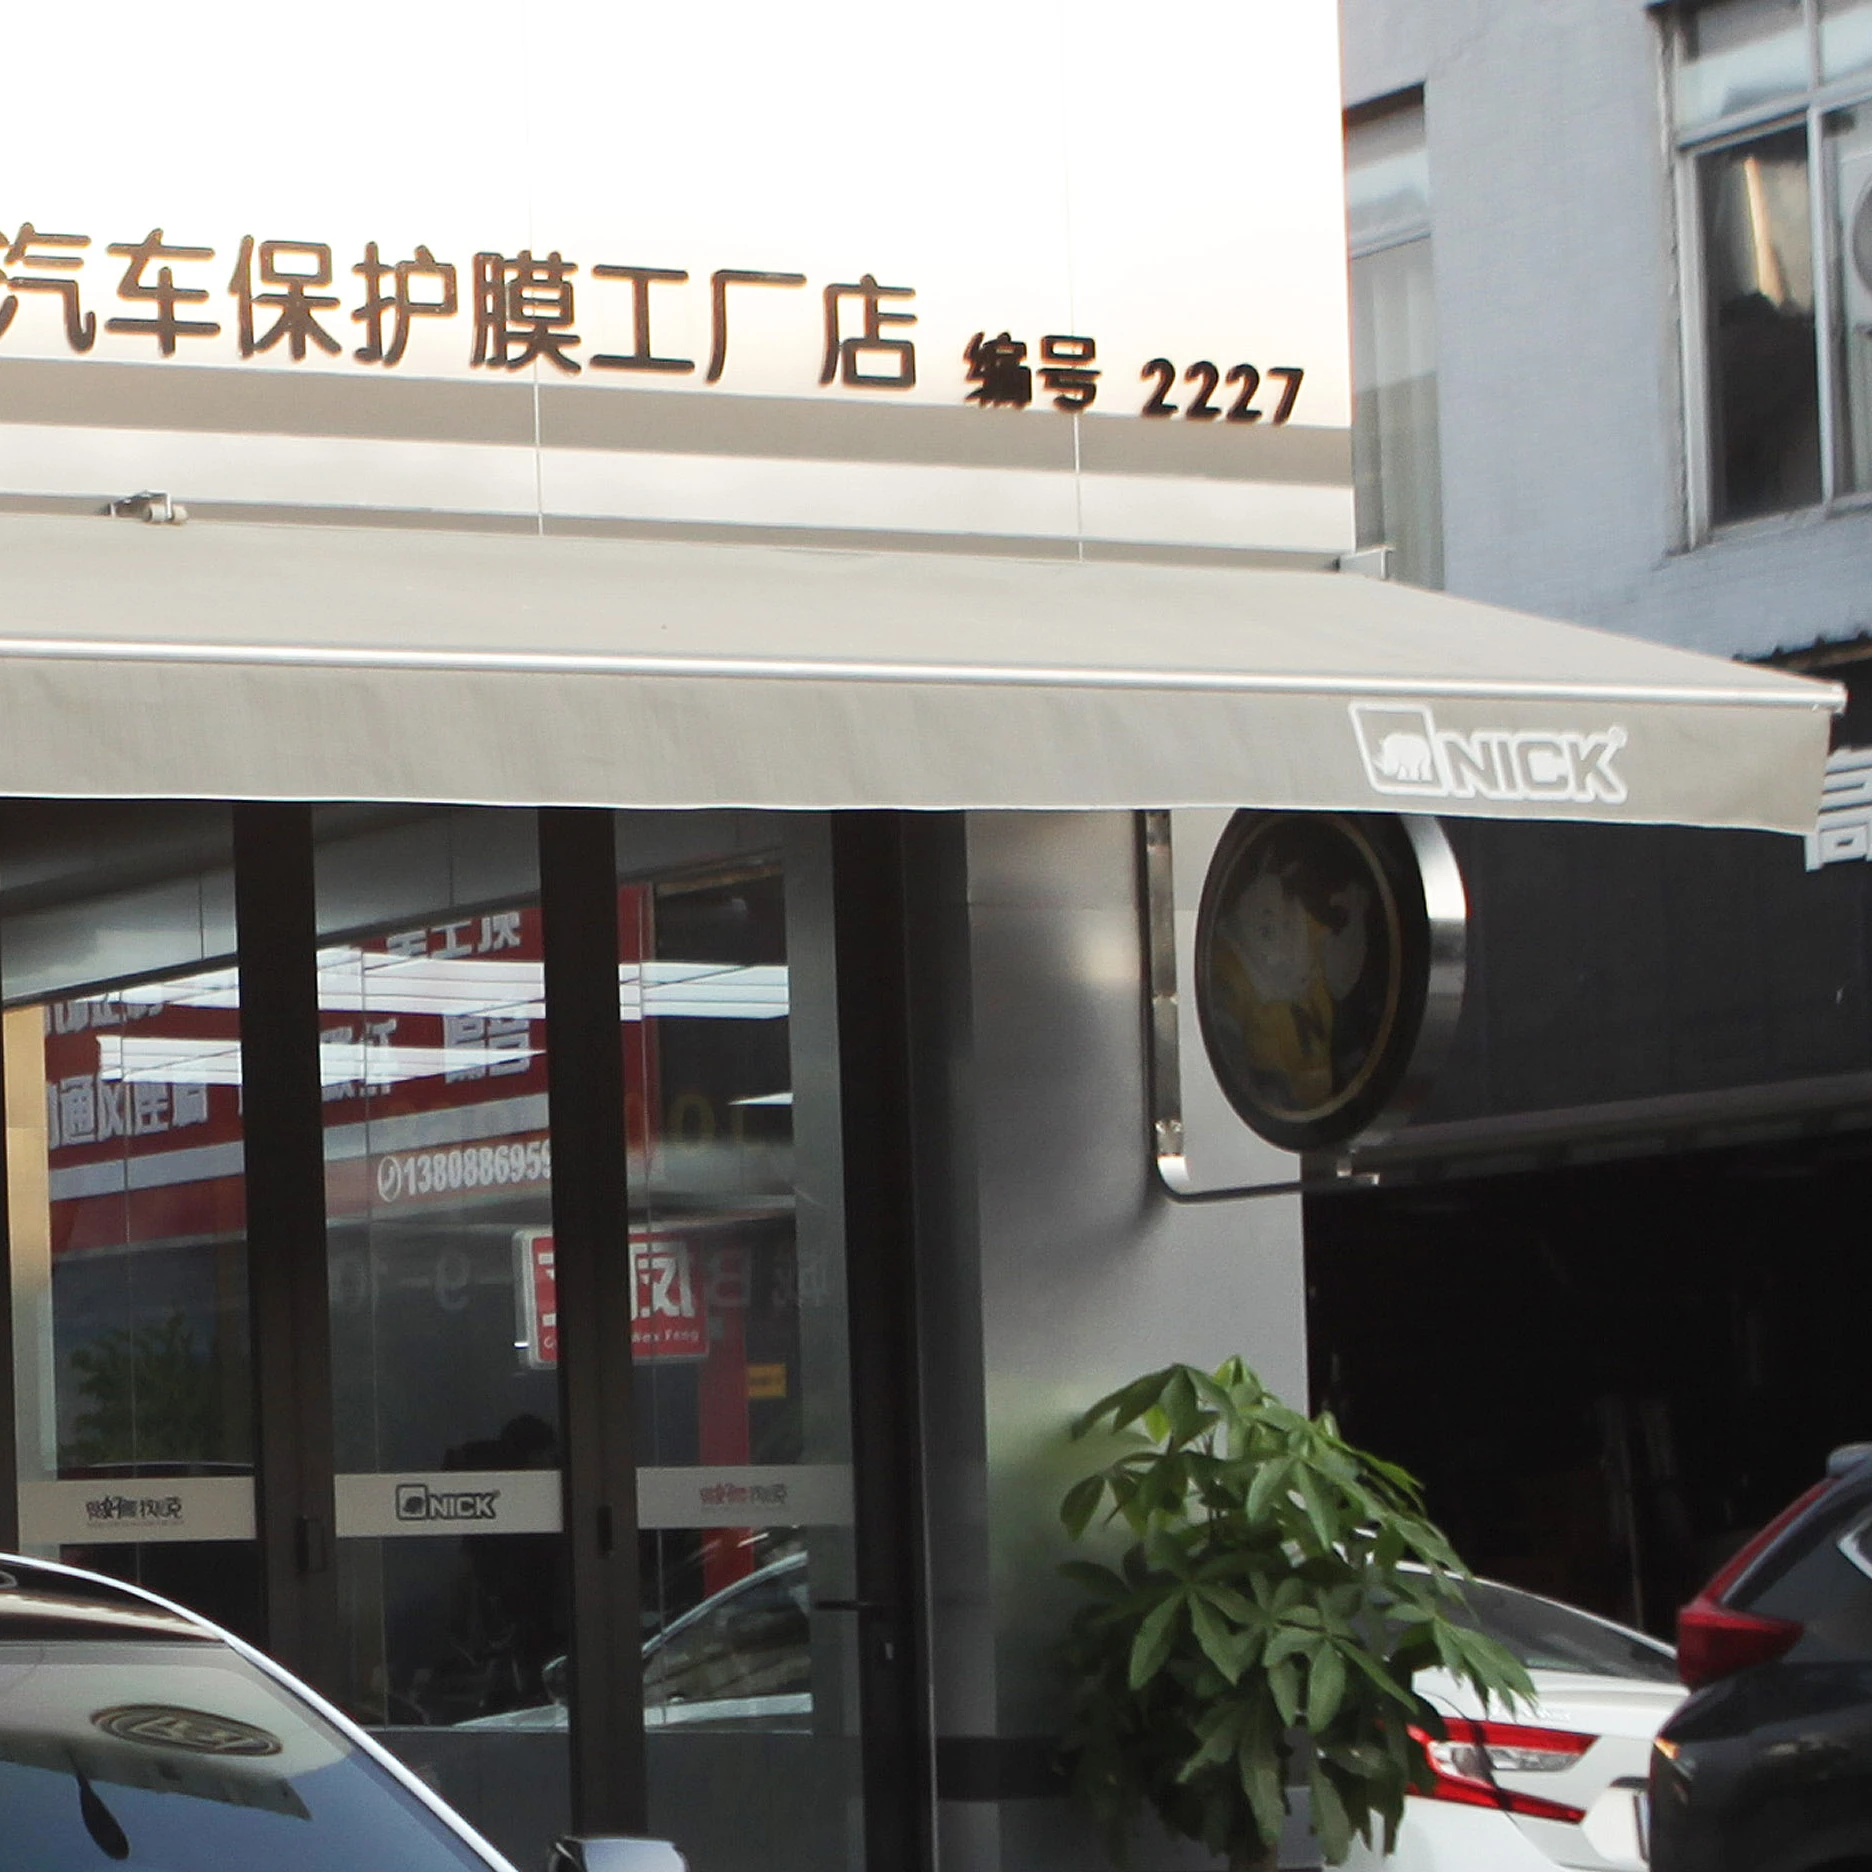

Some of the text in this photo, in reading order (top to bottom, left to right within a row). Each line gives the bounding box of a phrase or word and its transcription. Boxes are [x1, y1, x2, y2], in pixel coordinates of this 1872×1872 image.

[962, 331, 1306, 426] 编号 2227
[1434, 730, 1627, 804] NICK
[427, 1491, 498, 1520] NICK
